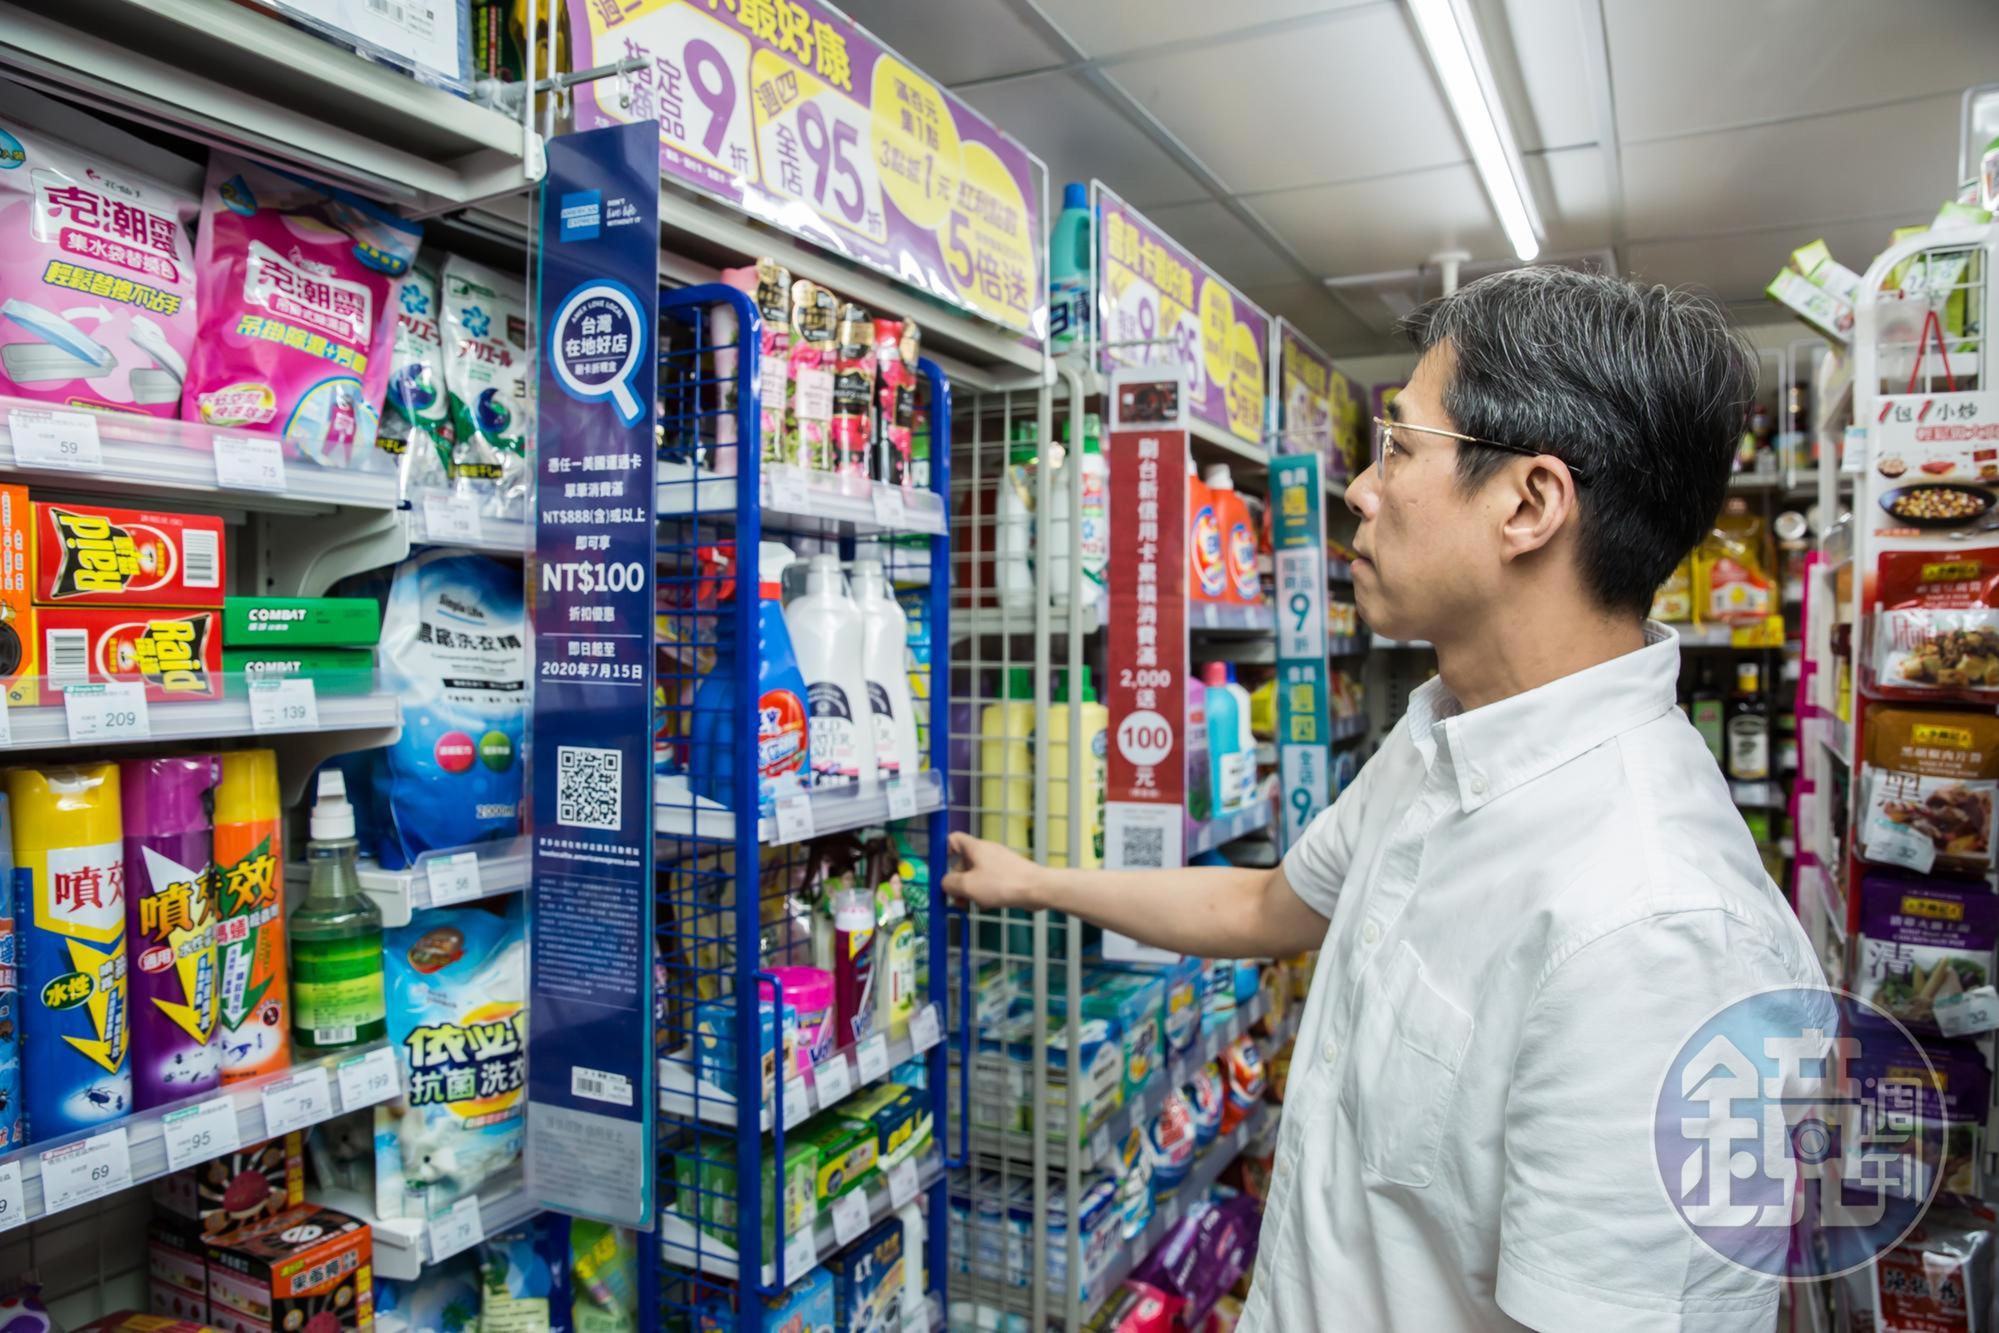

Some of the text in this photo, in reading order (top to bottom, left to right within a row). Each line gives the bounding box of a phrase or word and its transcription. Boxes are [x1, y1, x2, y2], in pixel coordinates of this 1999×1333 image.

[708, 0, 854, 92] 最好康
[581, 314, 613, 335] 台灣
[565, 333, 628, 358] 在地好店
[60, 440, 78, 455] 59
[59, 516, 126, 592] Raid
[542, 561, 645, 594] NT$100
[248, 608, 308, 622] COMBAT
[1289, 592, 1311, 632] 9
[148, 620, 206, 691] Raid
[541, 661, 643, 680] 2020年7月15日
[105, 711, 136, 728] 209
[1123, 726, 1168, 749] 100
[46, 976, 93, 1007] 水性
[191, 1130, 212, 1150] 95
[91, 1164, 110, 1181] 69
